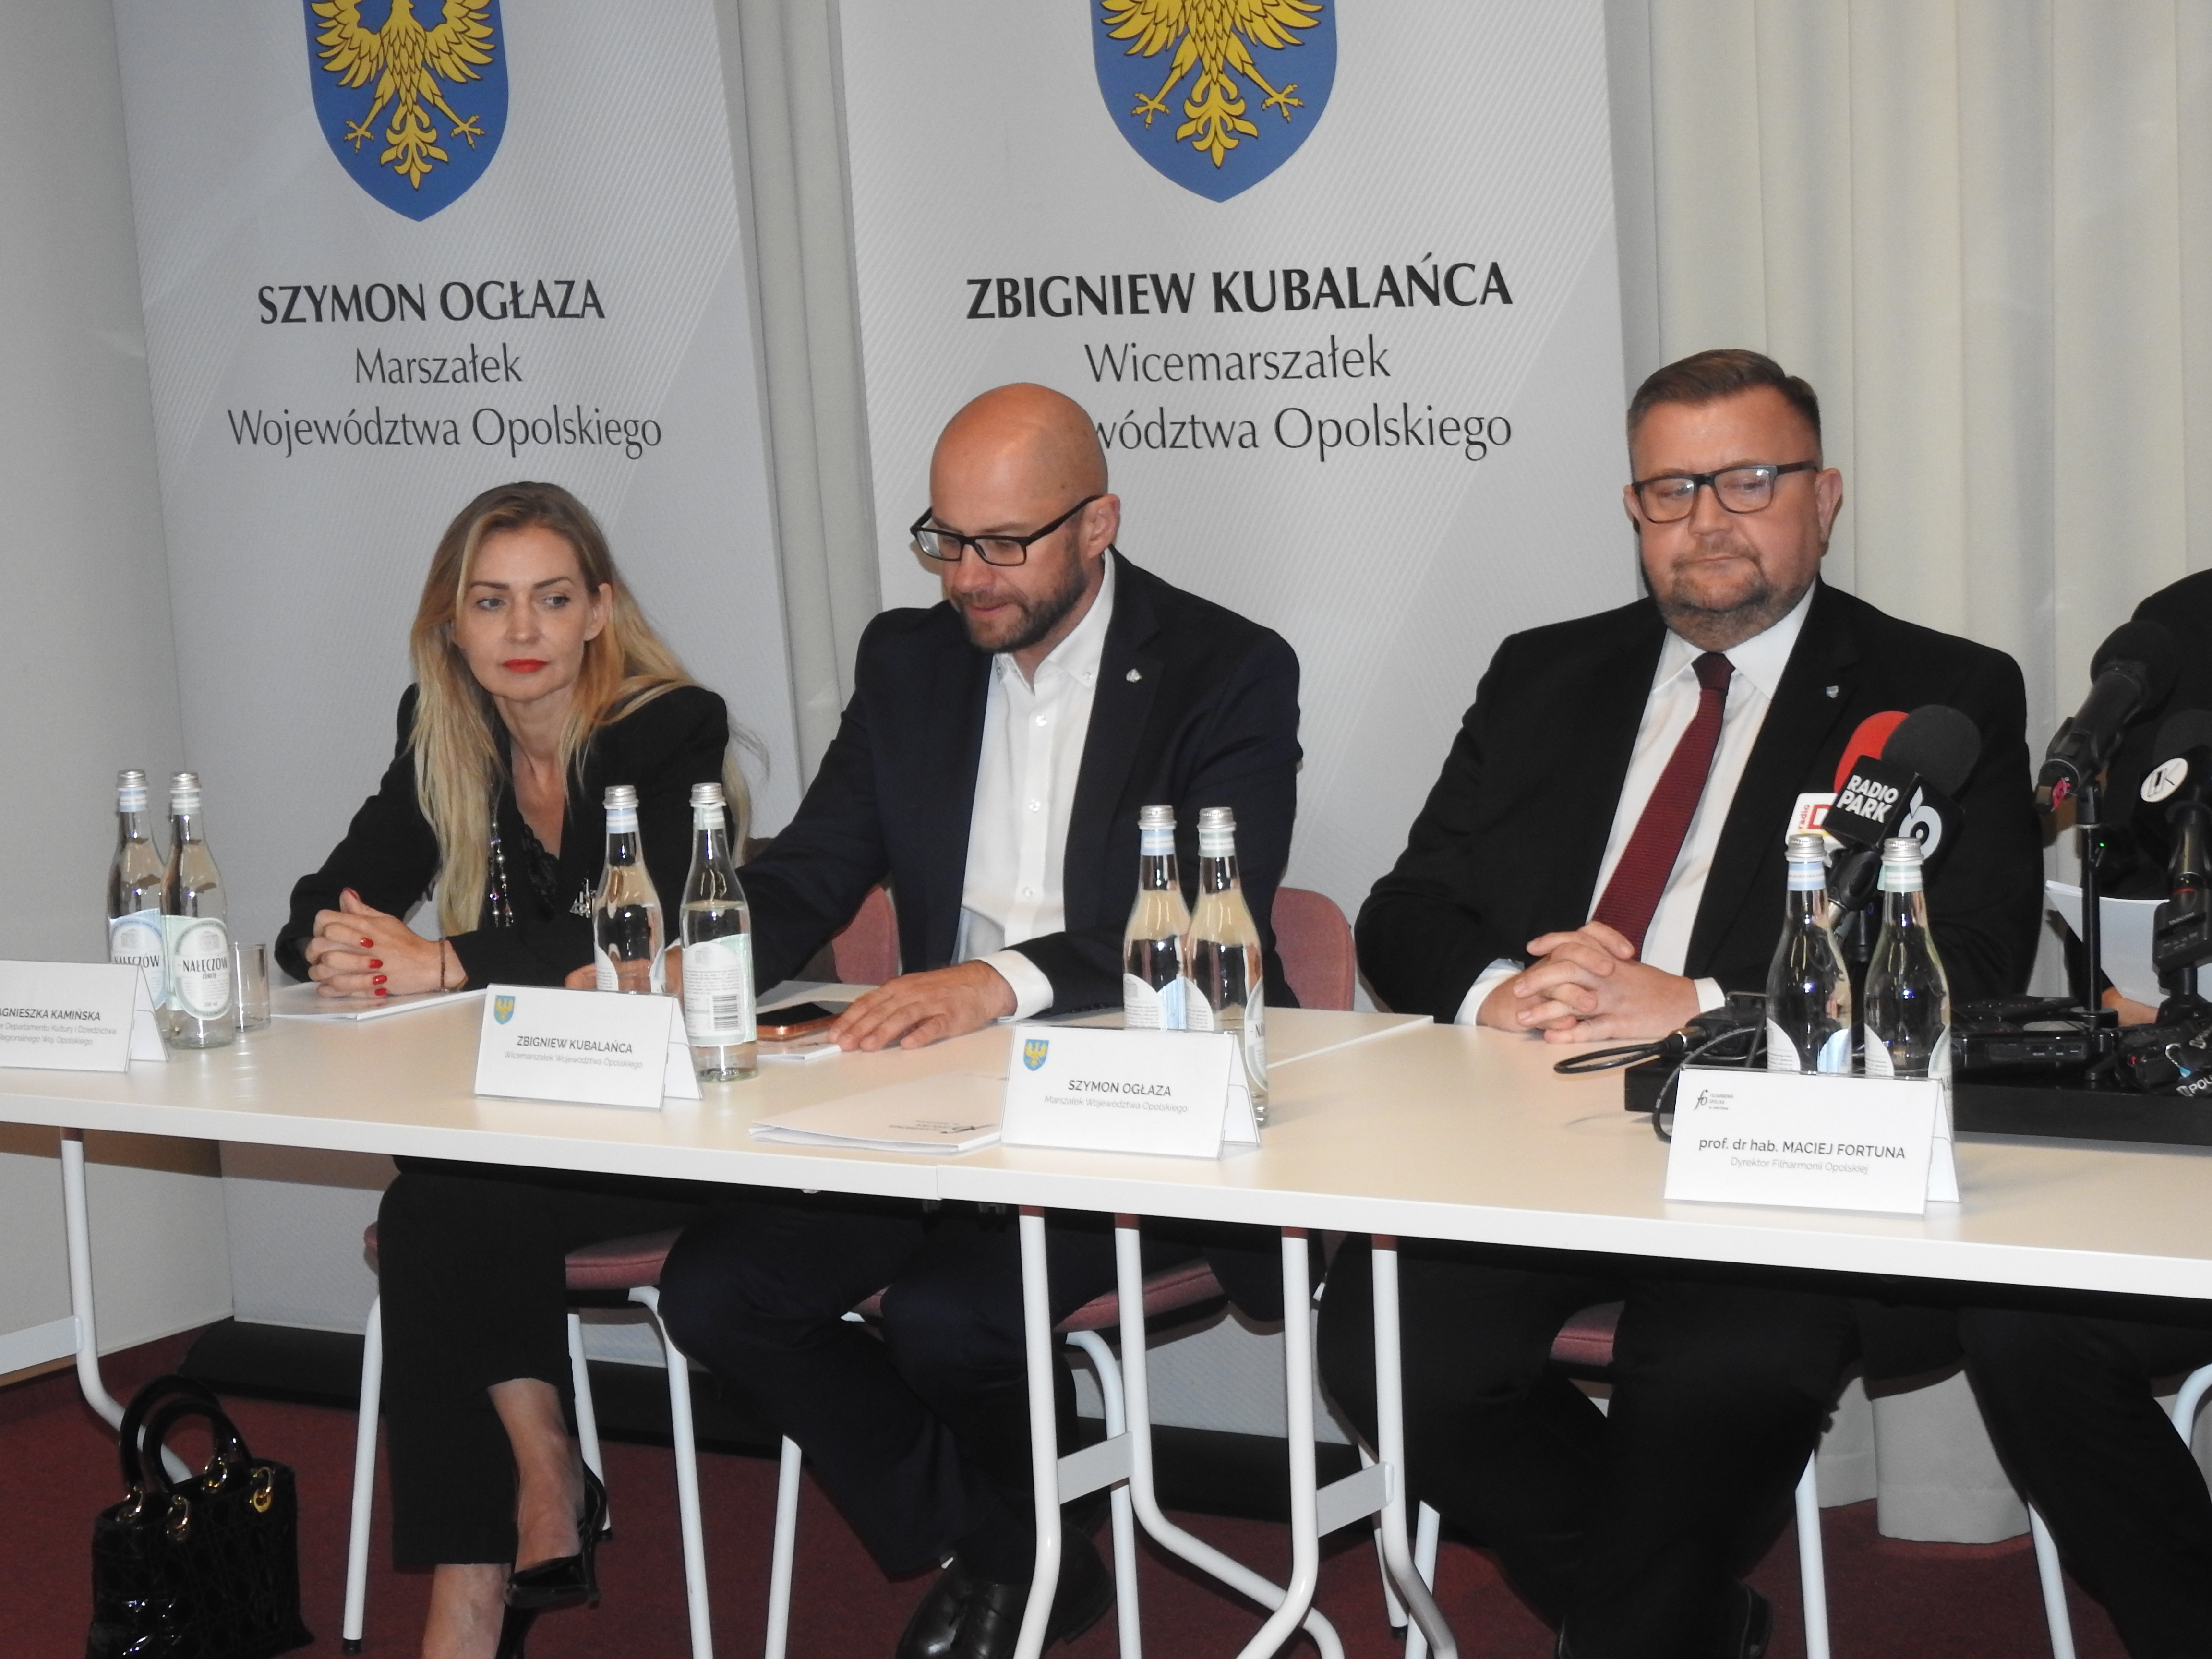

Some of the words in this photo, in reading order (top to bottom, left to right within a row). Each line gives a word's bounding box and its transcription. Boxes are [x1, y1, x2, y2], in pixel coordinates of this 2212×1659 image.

[966, 272, 1195, 320] ZBIGNIEW
[1213, 252, 1513, 313] KUBALAŃCA
[258, 282, 426, 324] SZYMON
[439, 279, 605, 321] OGŁAZA
[355, 342, 523, 384] Marszałek
[1085, 334, 1391, 383] Wicemarszałek
[228, 406, 460, 458] Województwa
[472, 404, 662, 460] Opolskiego
[1274, 402, 1512, 462] Opolskiego
[1847, 774, 1899, 804] RADIO
[1798, 804, 1810, 830] radio
[1836, 790, 1893, 824] PARK
[0, 1008, 48, 1019] GNIESZKA
[51, 1009, 100, 1021] KAMIŃSKA
[56, 1036, 93, 1046] Opolskiego
[517, 1036, 567, 1048] ZBIGNIEW
[569, 1039, 633, 1054] KUBALAŃCA
[603, 1058, 643, 1070] Opolskiego
[1068, 1080, 1119, 1093] SZYMON
[1122, 1083, 1171, 1096] OGŁAZA
[1044, 1095, 1083, 1105] Marszałek
[1085, 1098, 1140, 1109] Województwa
[1142, 1102, 1188, 1114] Opolskiego
[1699, 1137, 1728, 1151] prof.
[1732, 1138, 1747, 1150] dr
[1750, 1139, 1778, 1152] hab.
[1782, 1141, 1833, 1155] MACIEJ
[1837, 1144, 1906, 1159] FORTUNA
[1731, 1157, 1769, 1168] Dyrektor
[1771, 1159, 1822, 1170] Filharmonii
[1825, 1162, 1868, 1174] Opolskiej
